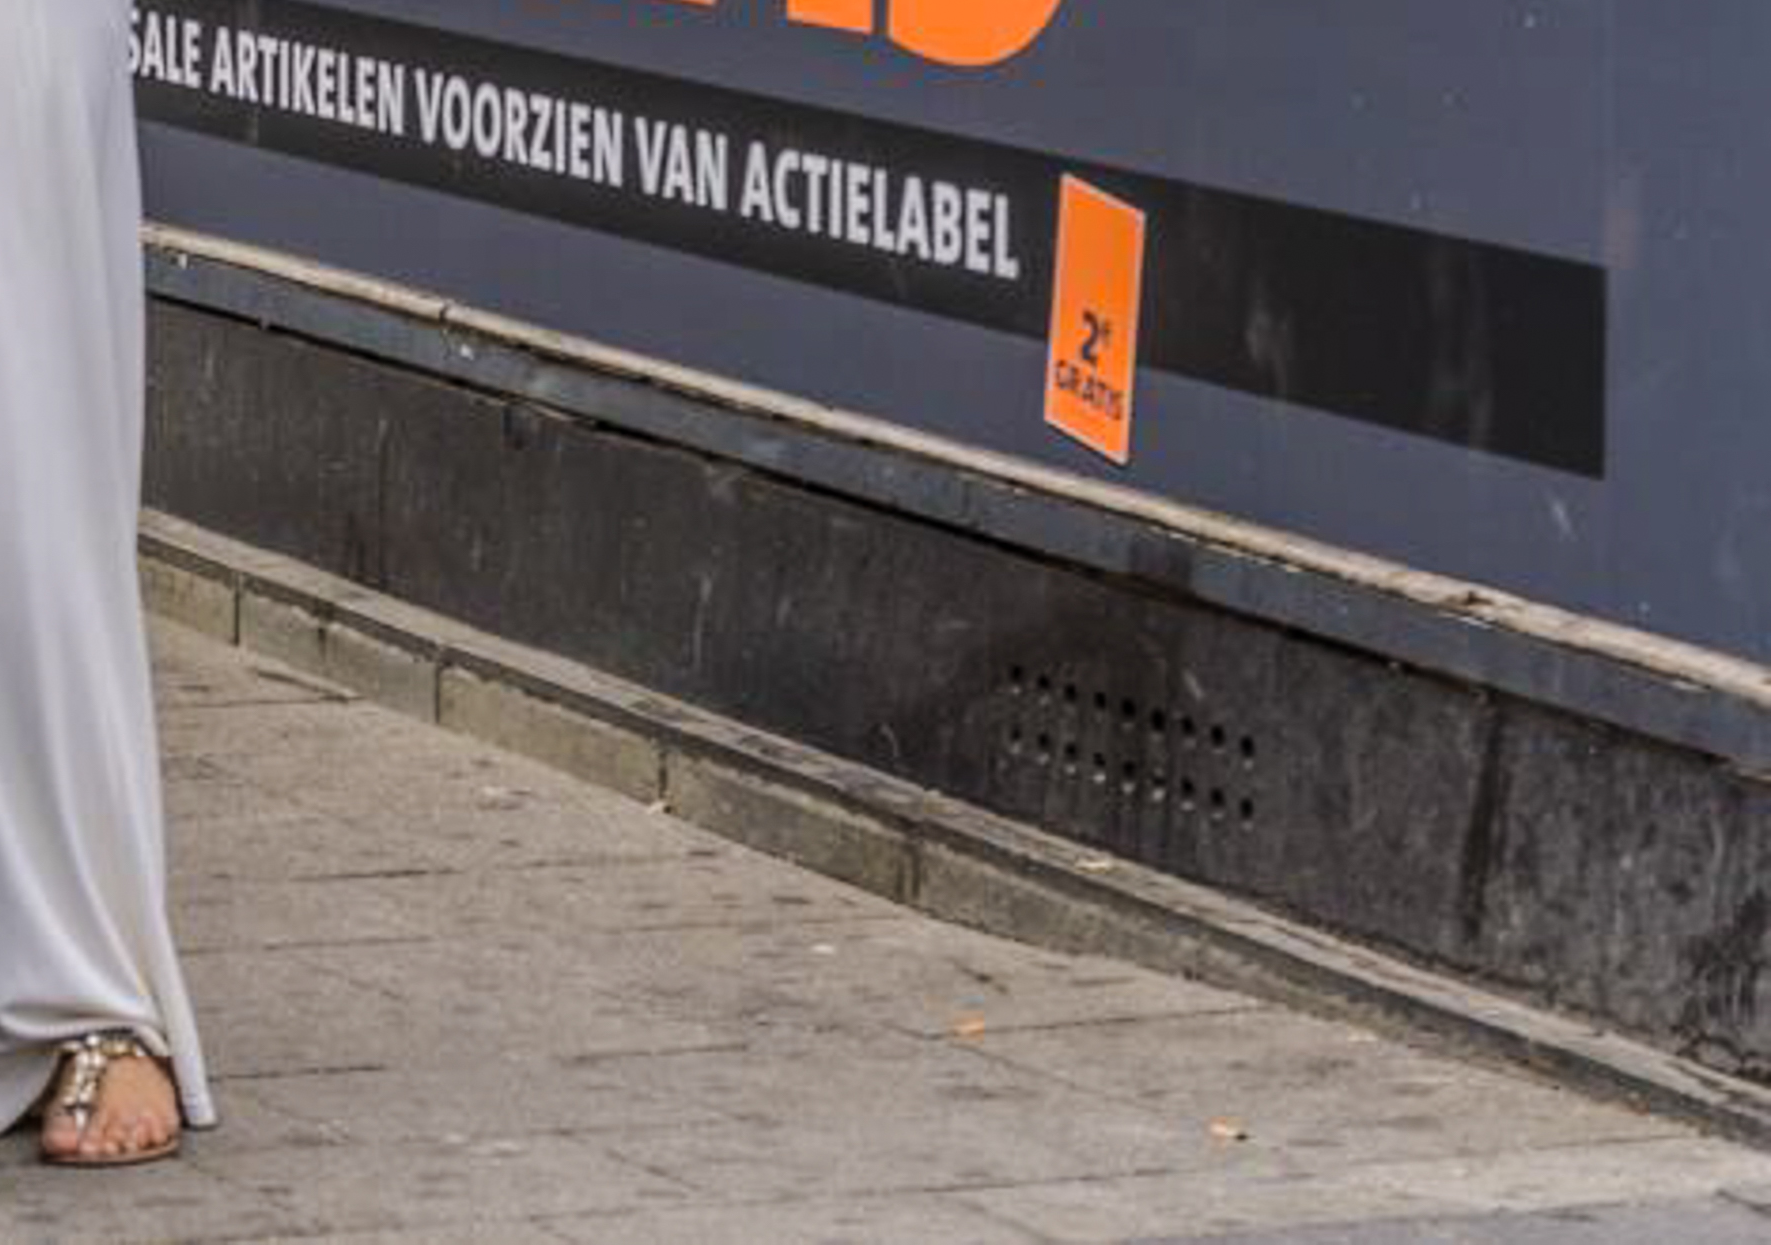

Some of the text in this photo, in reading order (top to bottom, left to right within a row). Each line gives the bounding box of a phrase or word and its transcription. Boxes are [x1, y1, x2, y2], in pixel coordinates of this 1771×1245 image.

[210, 26, 404, 135] ARTIKELEN
[415, 68, 624, 186] VOORZIEN
[634, 117, 728, 211] VAN
[740, 142, 1019, 280] ACTIELABEL
